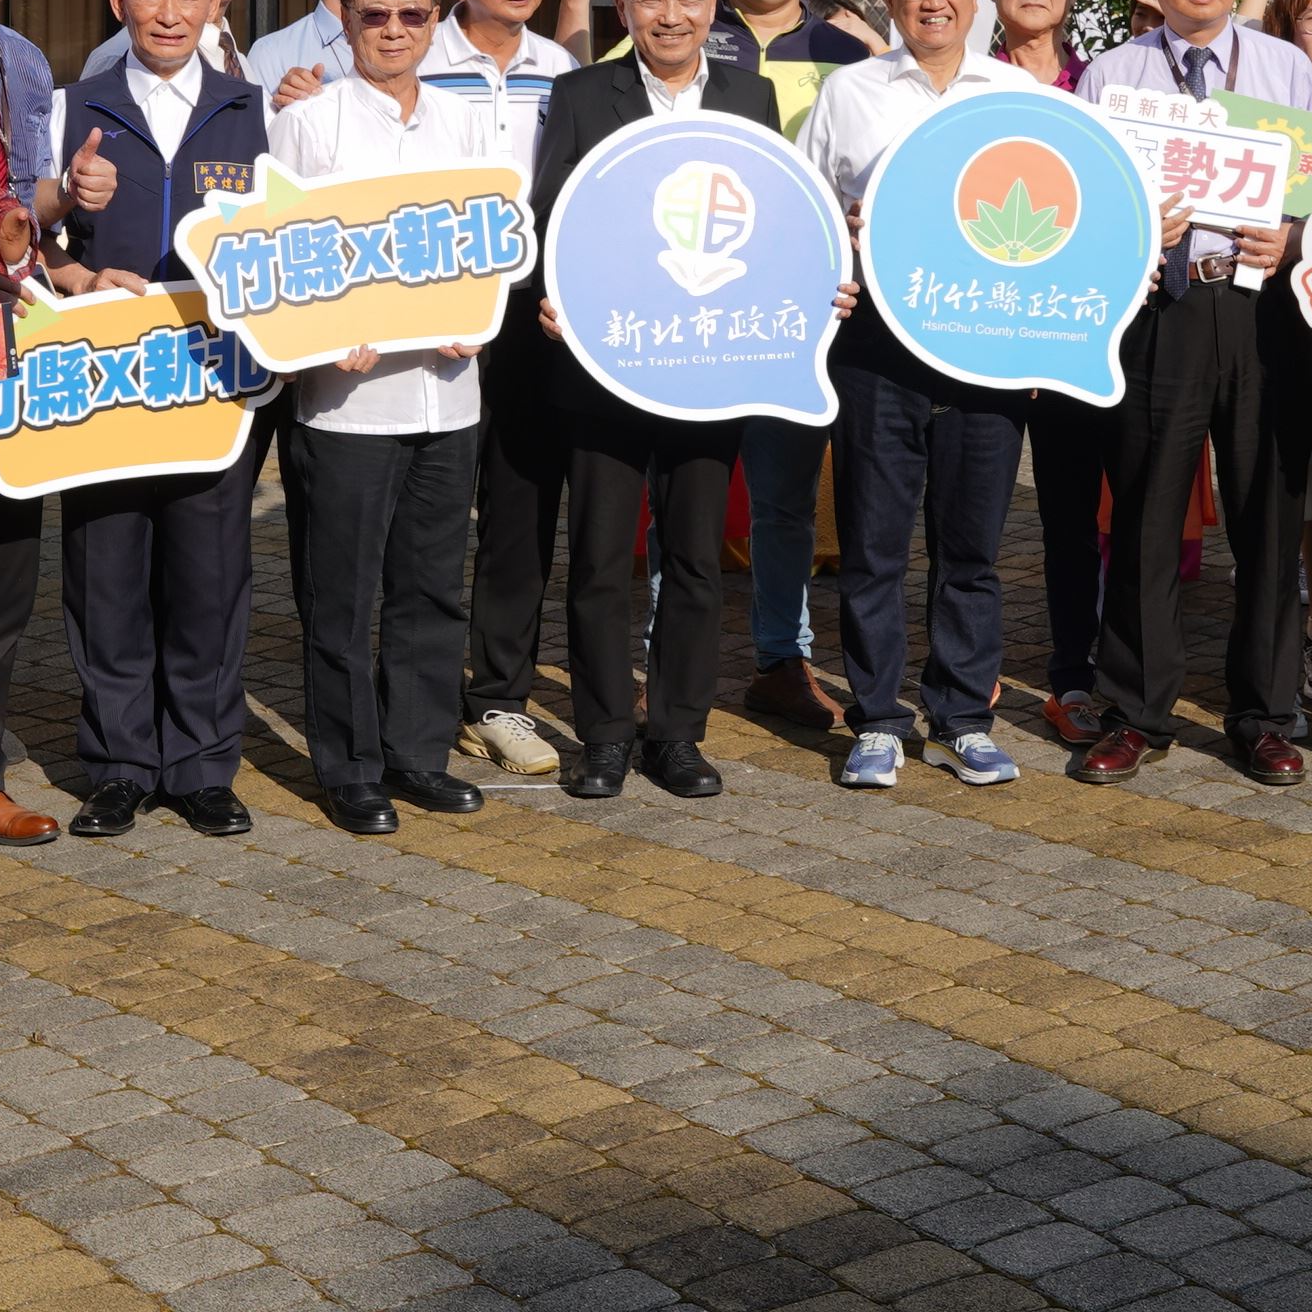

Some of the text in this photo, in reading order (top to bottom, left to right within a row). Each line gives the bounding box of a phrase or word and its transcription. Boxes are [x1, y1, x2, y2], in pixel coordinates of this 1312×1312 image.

[1108, 93, 1219, 128] 明新科大
[1160, 137, 1276, 208] 勢力
[902, 266, 1109, 326] 新竹縣政府
[601, 299, 808, 353] 新北市政府
[922, 319, 1088, 342] HsinChu County Government
[617, 351, 796, 368] New Taipei City Government
